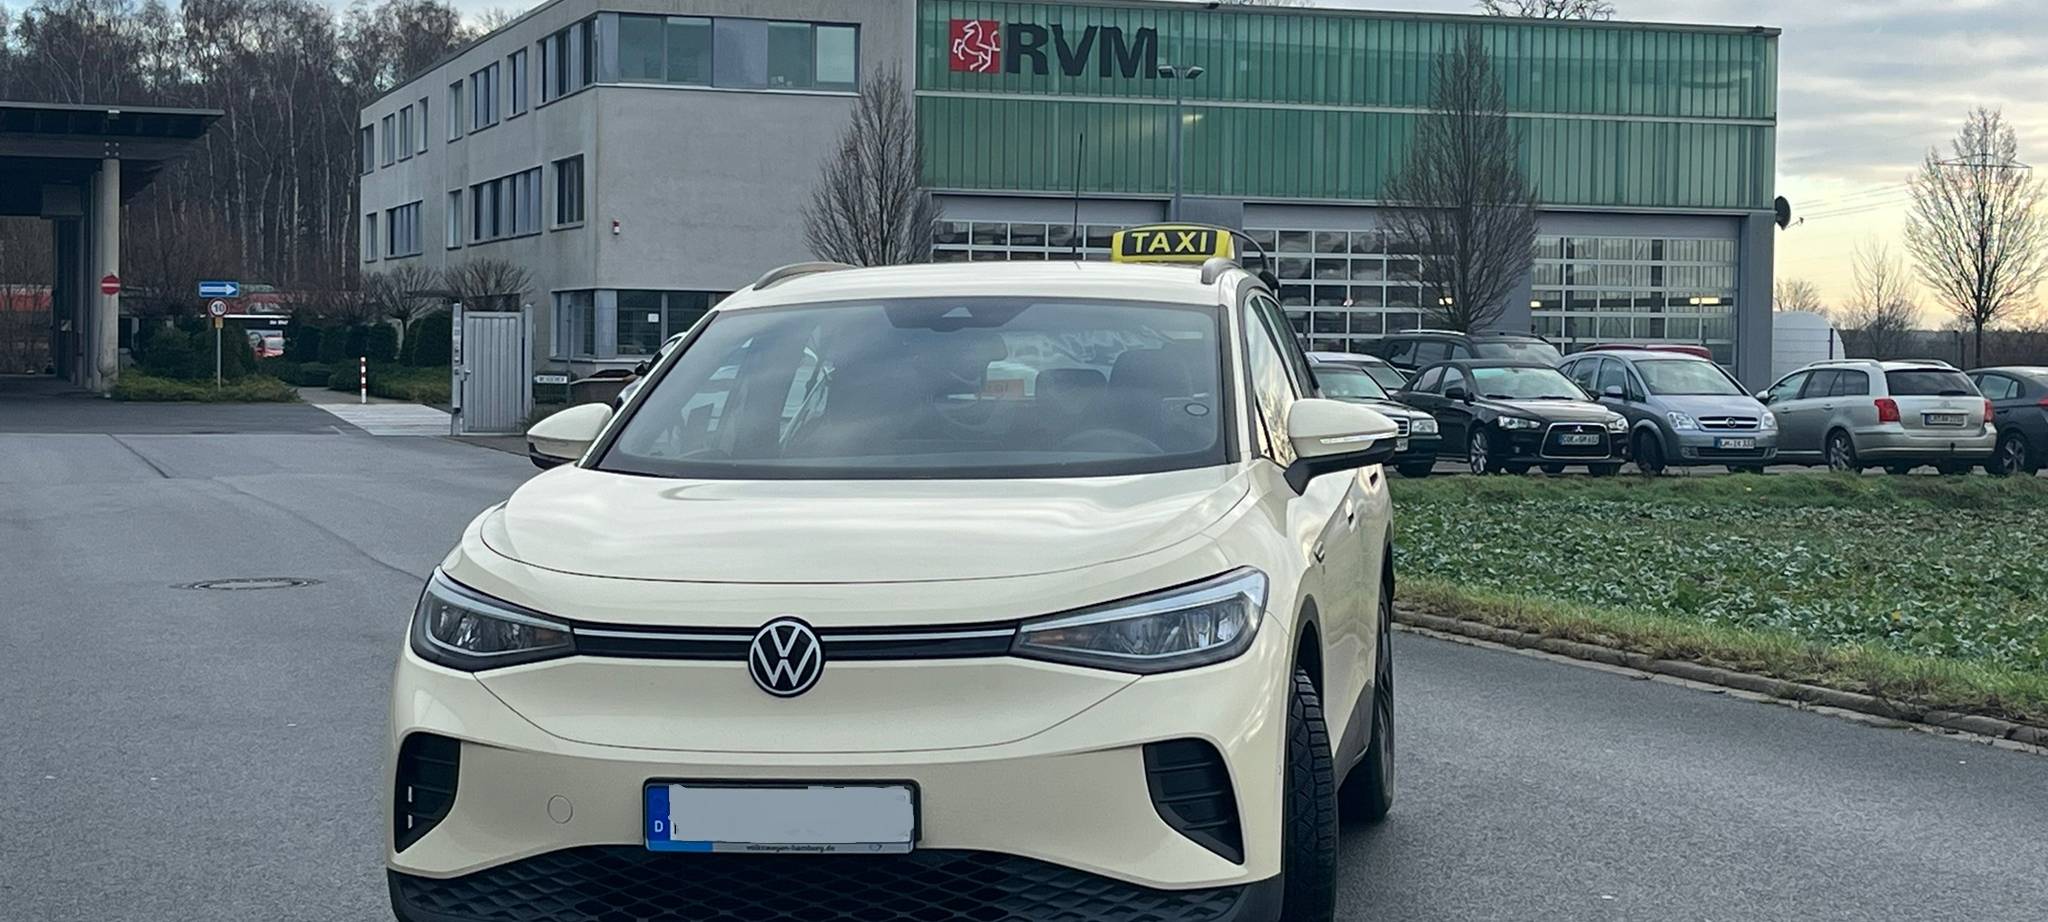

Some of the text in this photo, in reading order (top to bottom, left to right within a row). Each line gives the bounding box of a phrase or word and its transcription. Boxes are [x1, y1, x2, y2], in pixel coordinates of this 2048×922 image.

[1006, 22, 1158, 80] RVM
[1131, 231, 1209, 254] TAXI
[213, 303, 226, 313] 10
[752, 622, 819, 691] VW
[654, 820, 664, 833] D
